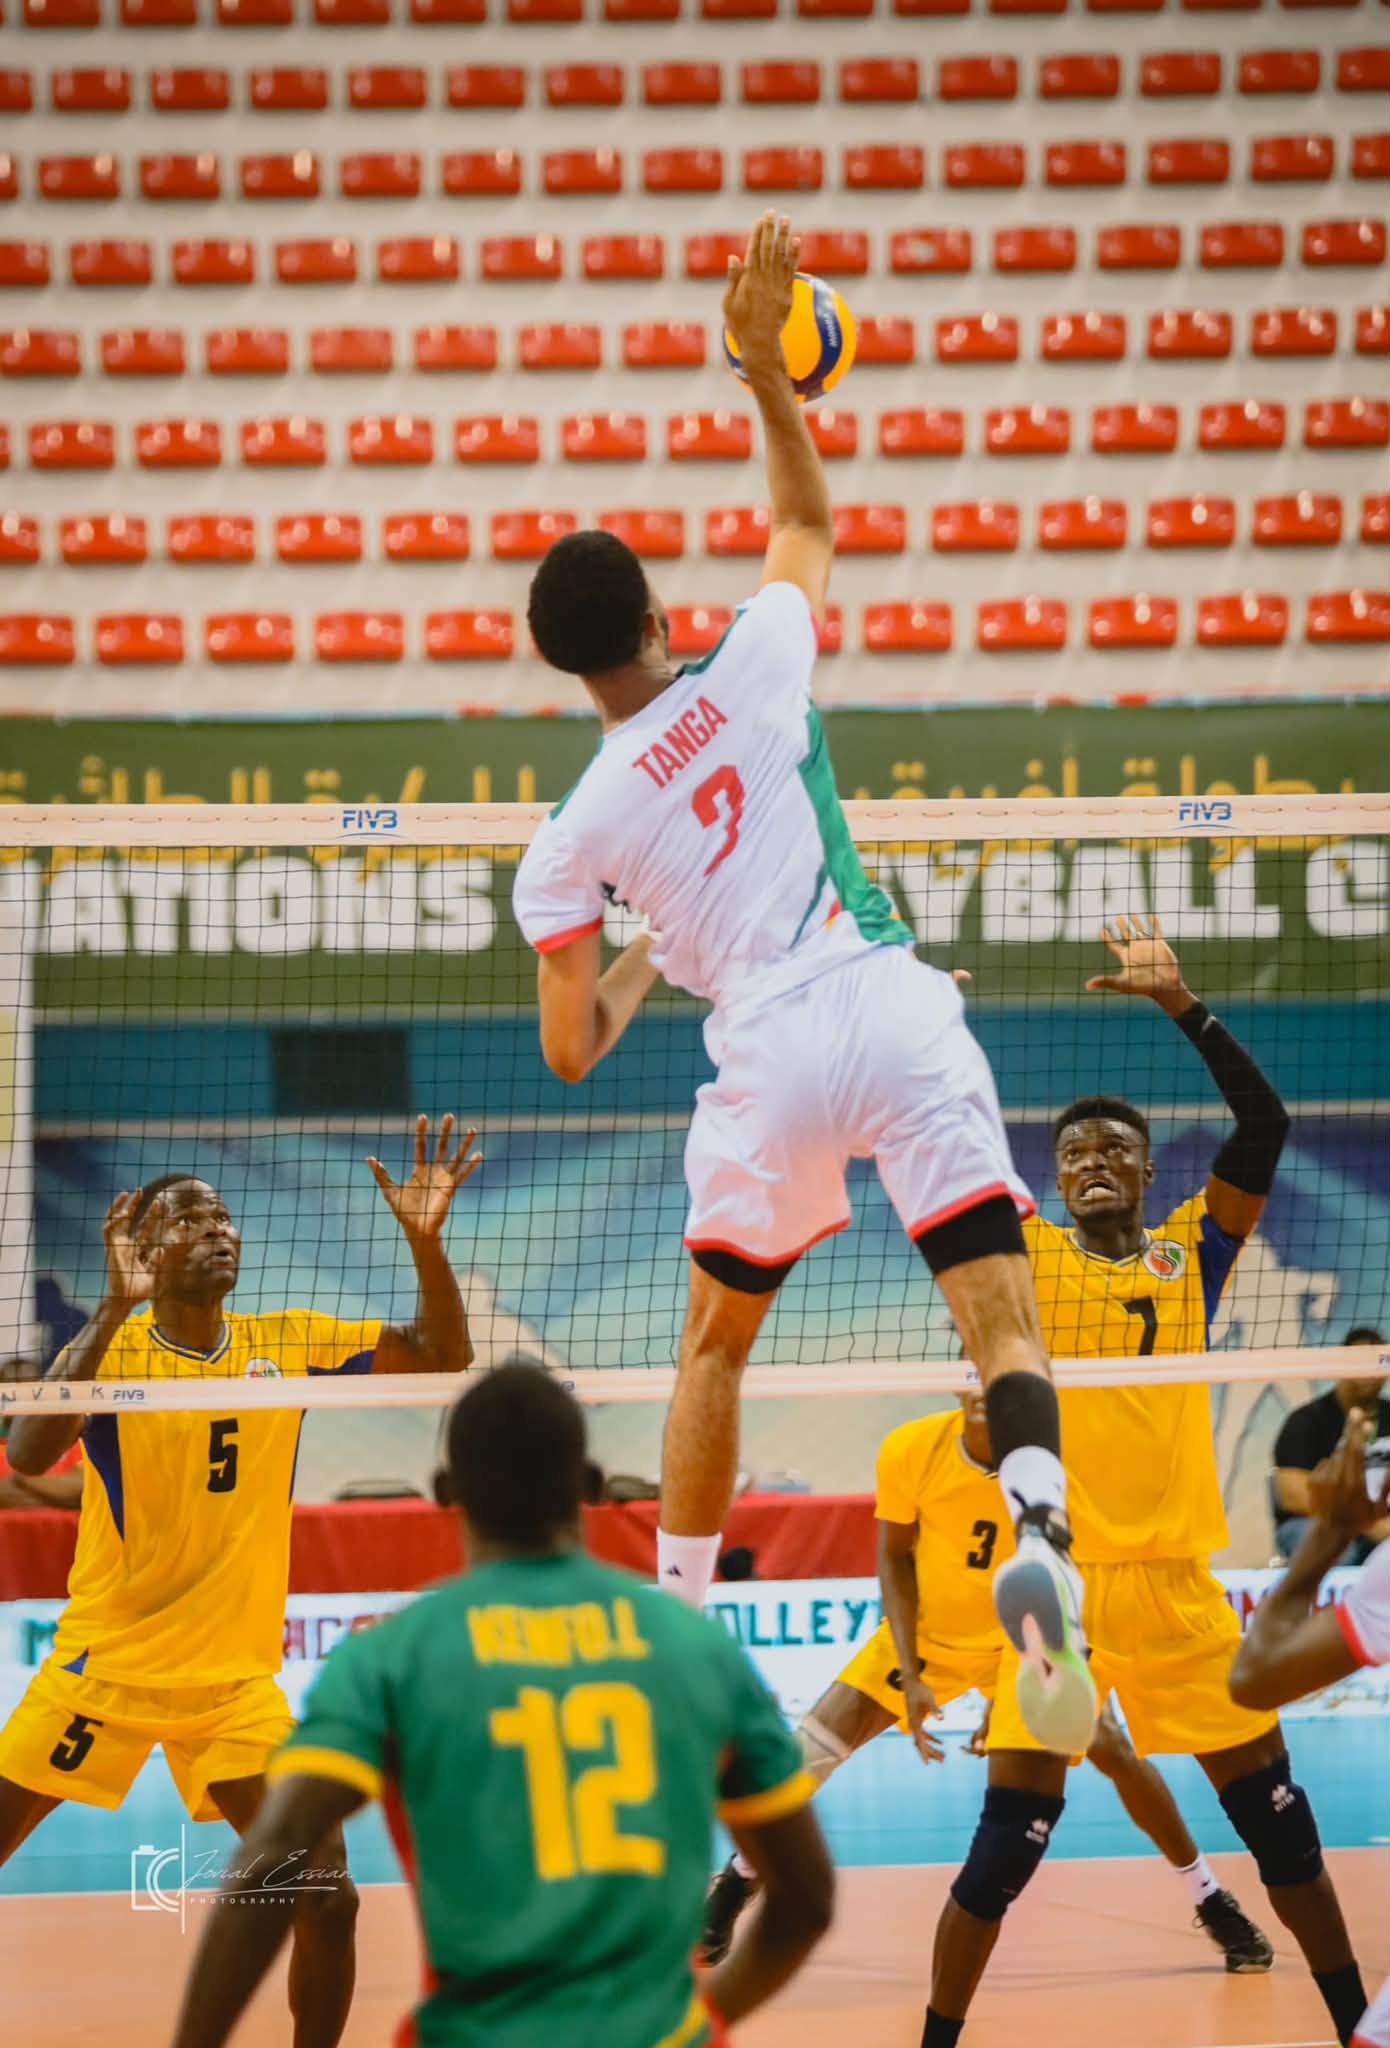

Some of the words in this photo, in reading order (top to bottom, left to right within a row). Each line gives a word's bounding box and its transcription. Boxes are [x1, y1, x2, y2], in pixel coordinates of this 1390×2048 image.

[632, 696, 728, 789] TANGA
[342, 810, 398, 829] FIVB
[1179, 803, 1232, 820] FIVB
[1122, 1295, 1158, 1356] 7
[113, 1389, 145, 1400] FIVB
[207, 1418, 239, 1493] 5
[967, 1520, 997, 1570] 3
[50, 1715, 103, 1772] 5
[489, 1682, 667, 1882] 12
